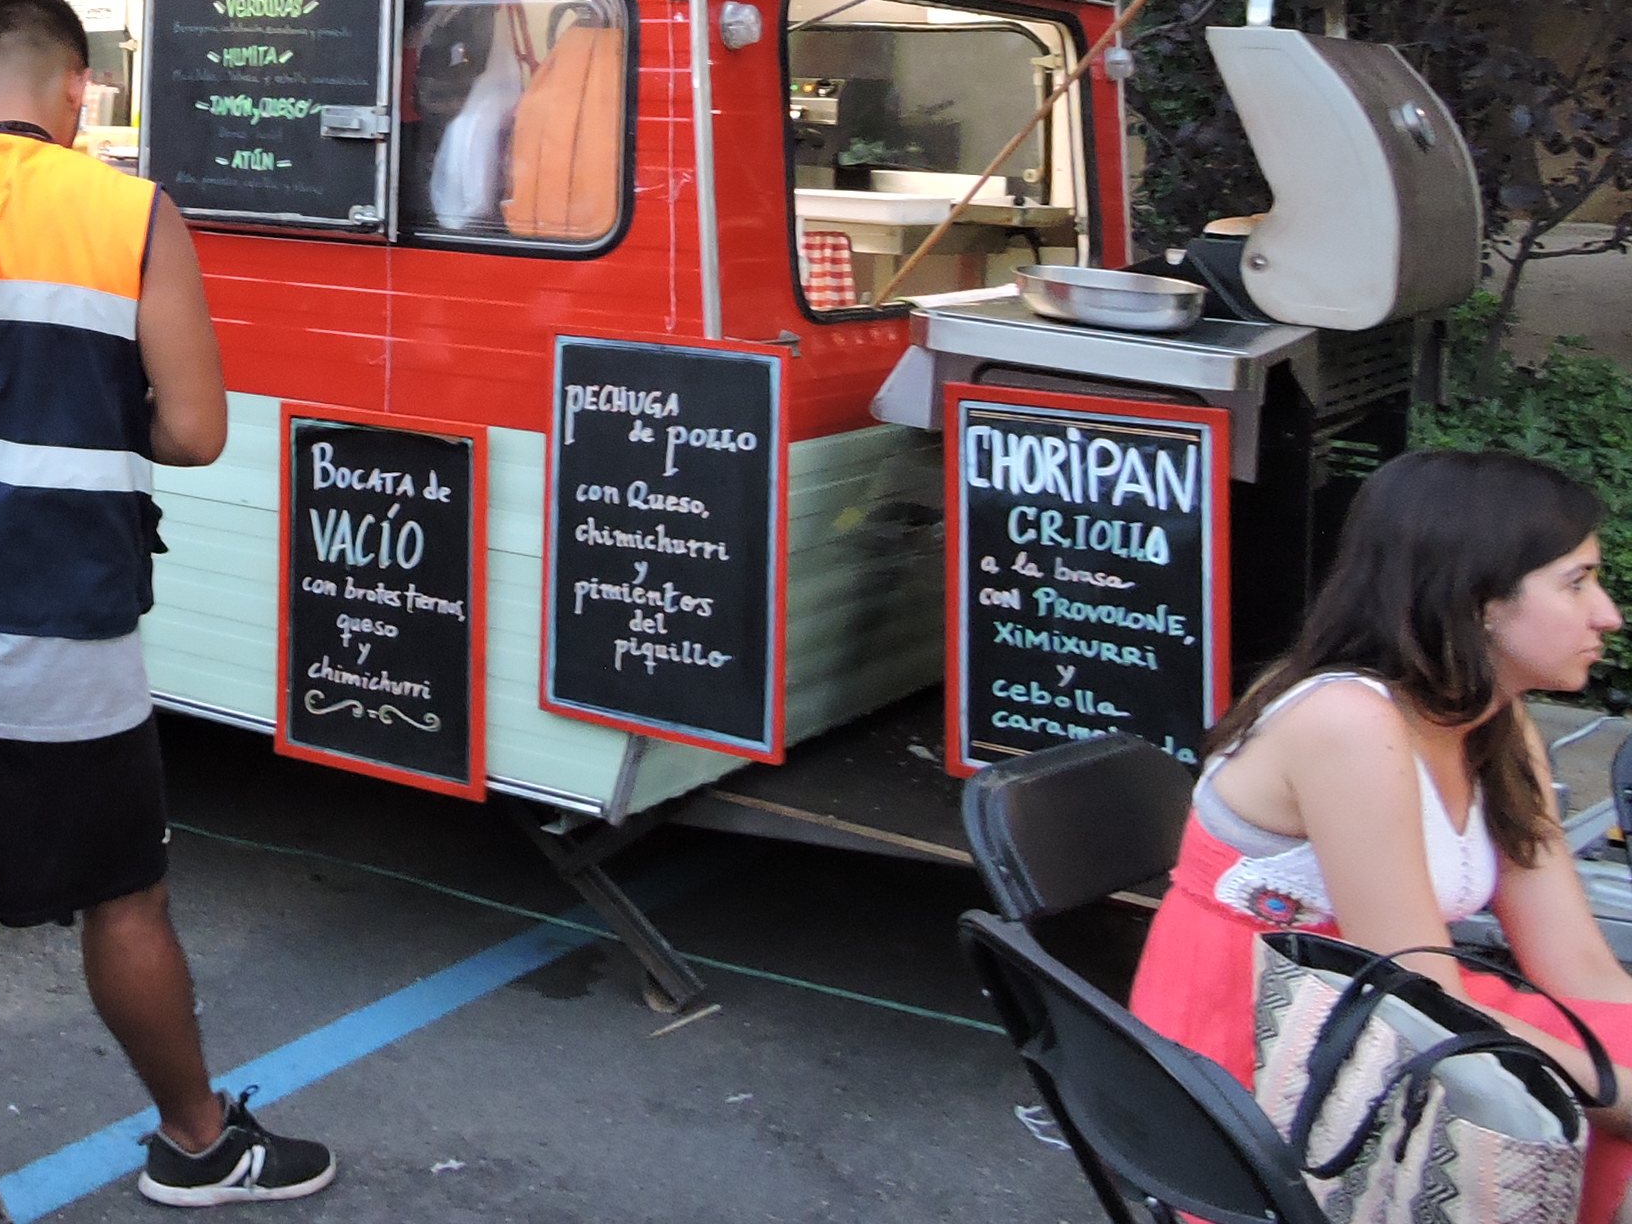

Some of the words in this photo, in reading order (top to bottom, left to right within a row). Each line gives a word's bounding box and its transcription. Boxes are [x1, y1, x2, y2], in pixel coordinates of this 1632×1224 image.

[231, 148, 275, 171] ATÚN
[629, 419, 655, 443] de
[423, 469, 452, 503] de
[575, 483, 620, 505] con
[626, 480, 710, 519] Queso,
[309, 503, 425, 570] VACÍO
[574, 516, 730, 561] chimichurri
[1007, 505, 1169, 565] CRIOLLO
[632, 561, 649, 585] y
[980, 556, 1000, 574] a
[1011, 551, 1044, 578] la
[1053, 557, 1137, 589] brasa
[302, 576, 338, 597] con
[344, 576, 402, 607] brotes
[574, 577, 714, 617] pimientos
[336, 613, 399, 648] queso
[628, 609, 668, 635] del
[356, 642, 372, 665] y
[614, 636, 734, 676] piquillo
[308, 655, 432, 700] chimichurri
[1056, 664, 1077, 688] y
[991, 679, 1132, 718] cebolla
